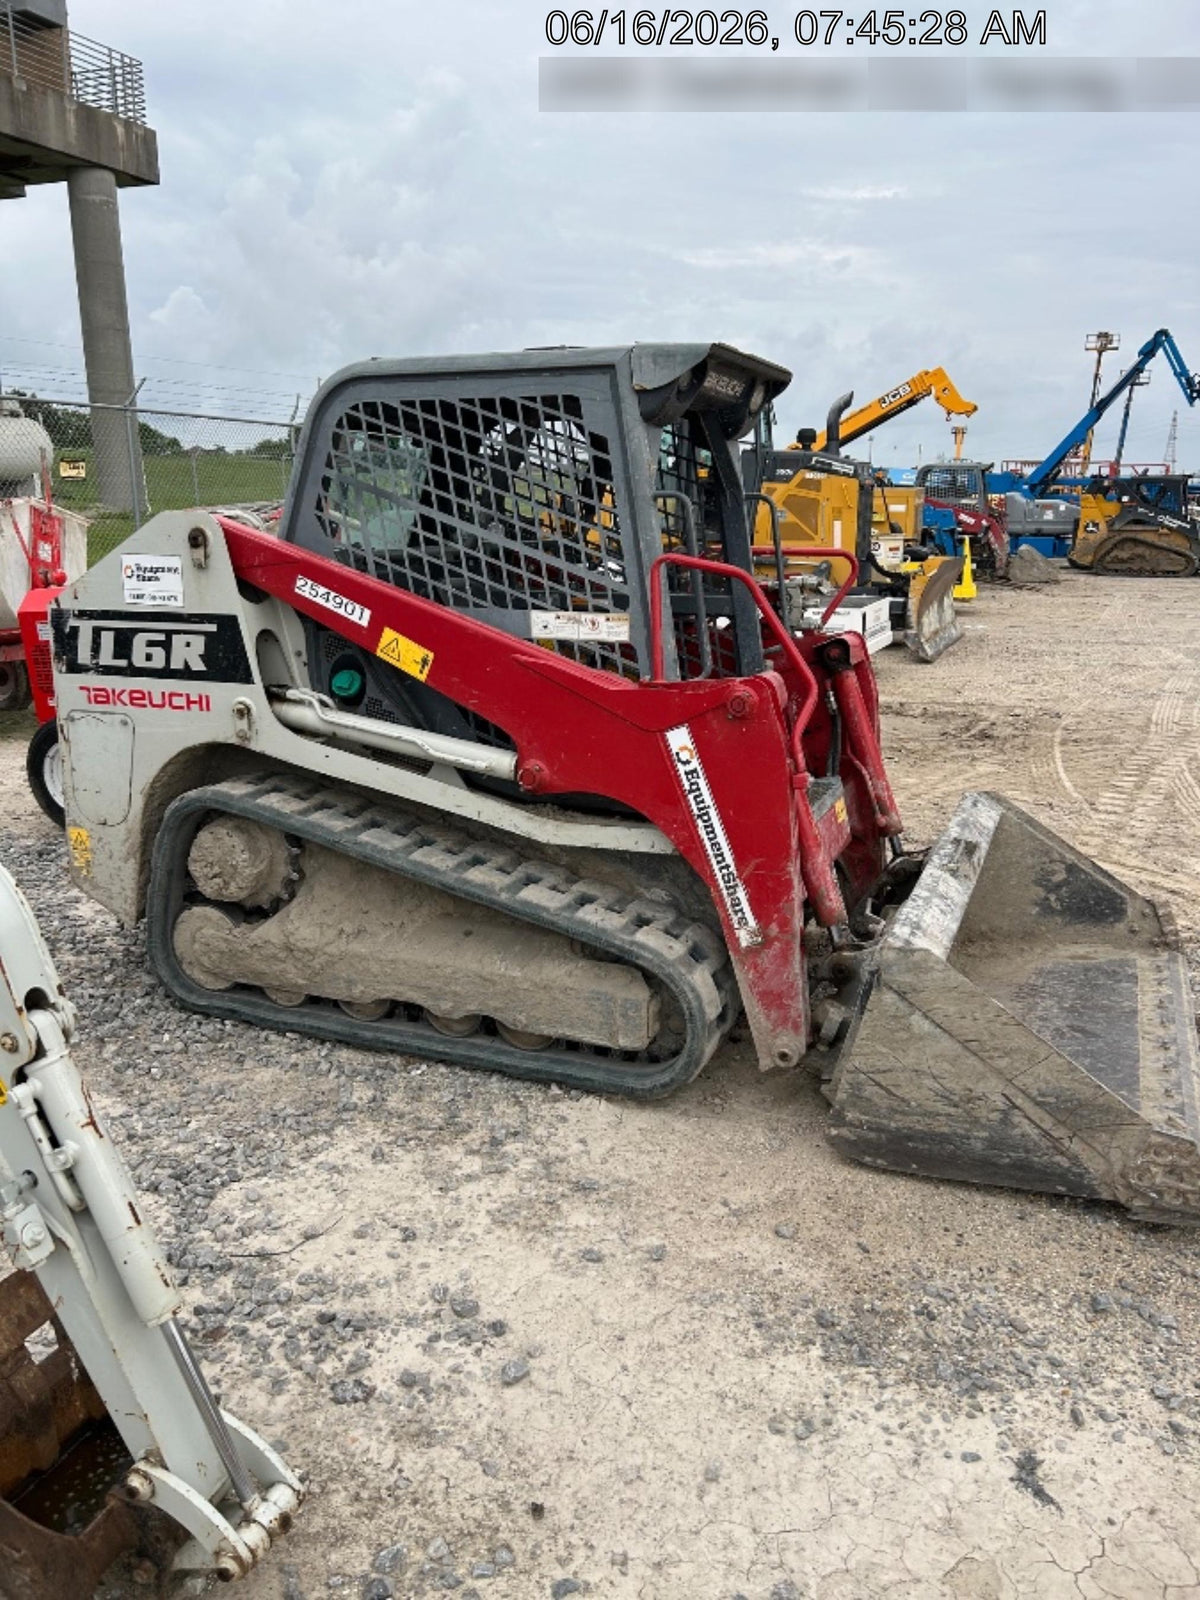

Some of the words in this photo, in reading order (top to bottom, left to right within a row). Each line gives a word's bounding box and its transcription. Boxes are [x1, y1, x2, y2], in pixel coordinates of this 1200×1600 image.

[881, 383, 911, 409] JCB
[296, 577, 365, 621] 254901
[65, 619, 218, 672] TL6R
[684, 767, 750, 930] EquipmentShare
